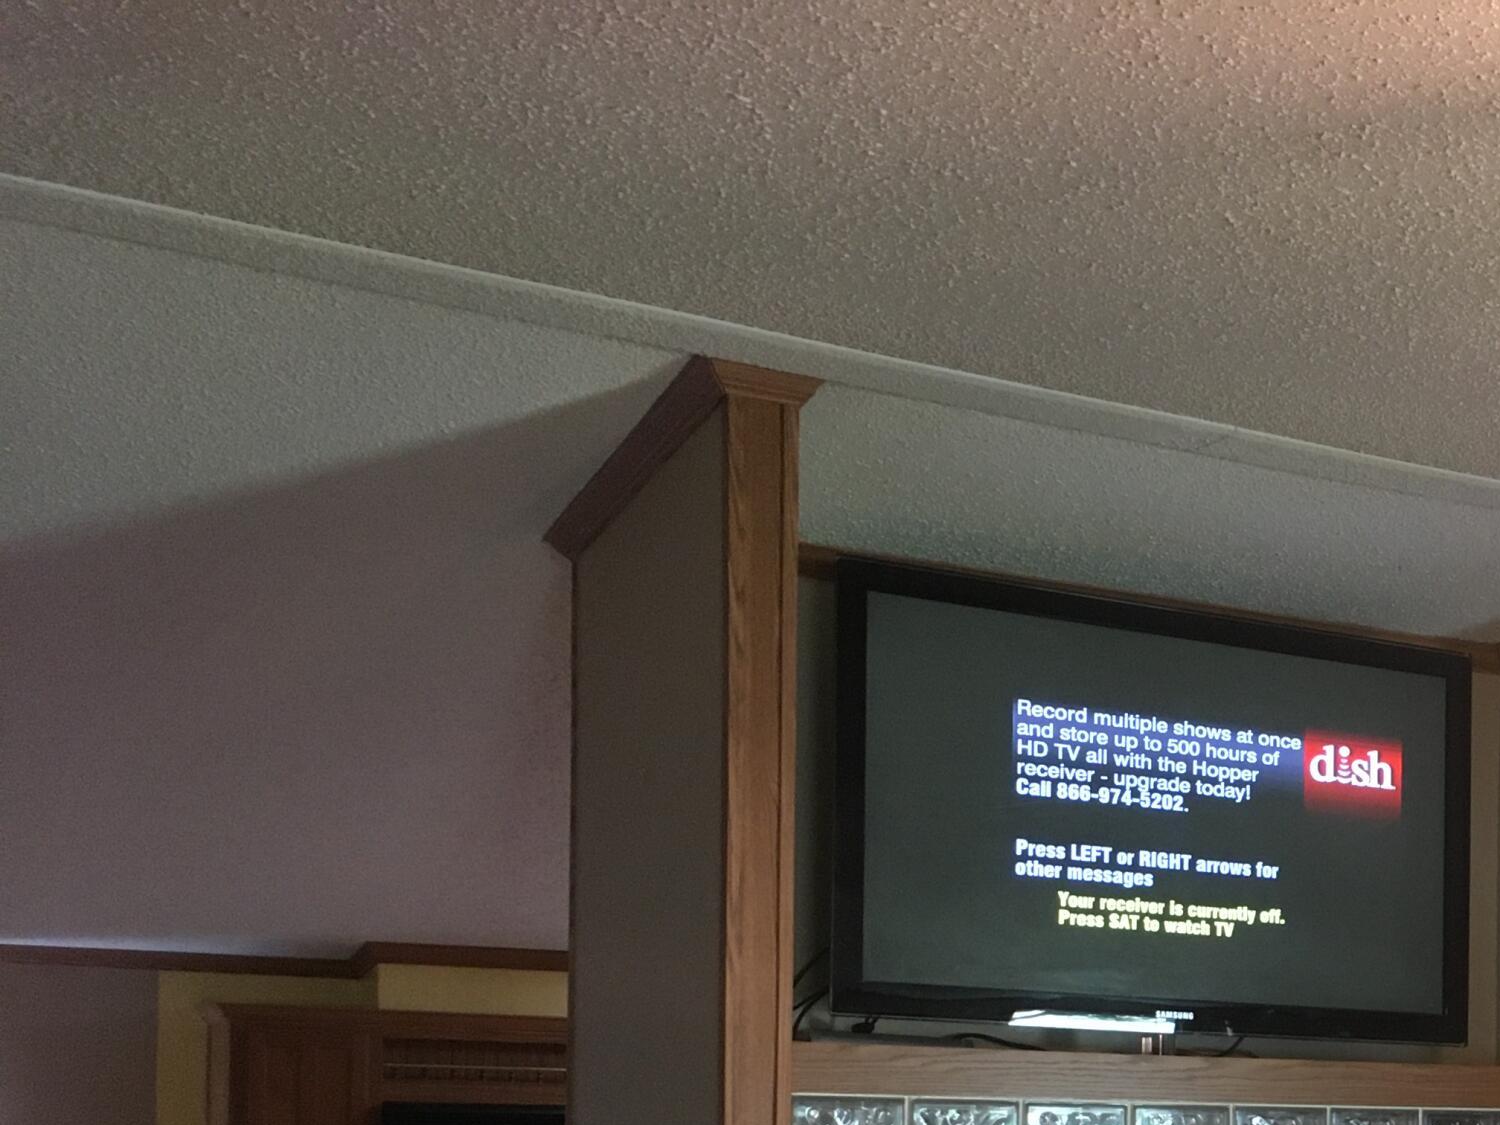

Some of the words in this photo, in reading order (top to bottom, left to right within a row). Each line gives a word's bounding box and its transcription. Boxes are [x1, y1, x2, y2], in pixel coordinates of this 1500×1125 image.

[1017, 699, 1087, 723] Record
[1094, 711, 1168, 734] multiple
[1173, 721, 1231, 742] shows
[1236, 729, 1253, 744] at
[1258, 733, 1302, 750] once
[1017, 721, 1054, 739] and
[1060, 725, 1108, 745] store
[1114, 734, 1138, 752] up
[1144, 736, 1162, 751] to
[1167, 740, 1200, 757] 500
[1206, 743, 1257, 764] hours
[1262, 751, 1280, 766] of
[1017, 739, 1048, 757] HD
[1054, 743, 1080, 761] TV
[1086, 748, 1108, 765] all
[1113, 751, 1152, 770] with
[1158, 756, 1187, 774] the
[1193, 760, 1259, 783] Hopper
[1017, 760, 1095, 783] receiver
[1114, 773, 1191, 795] upgrade
[1196, 780, 1251, 803] today!
[1309, 744, 1396, 790] dish
[1016, 778, 1051, 797] Call
[1057, 782, 1189, 812] 866-974-5202.
[1015, 860, 1062, 880] other
[1067, 866, 1154, 888] messages
[1016, 838, 1066, 860] Press
[1071, 843, 1112, 863] LEFT
[1117, 850, 1135, 866] or
[1139, 850, 1192, 871] RIGHT
[1196, 859, 1251, 877] arrows
[1256, 862, 1279, 879] for
[1058, 891, 1095, 910] Your
[1100, 897, 1165, 915] receiver
[1170, 900, 1184, 917] is
[1188, 903, 1256, 925] currently
[1260, 909, 1285, 925] off.
[1058, 909, 1104, 928] Press
[1109, 914, 1139, 930] SAT
[1143, 916, 1160, 932] to
[1164, 919, 1210, 937] watch
[1215, 922, 1235, 937] TV
[1155, 1010, 1194, 1020] SAMSUNG
